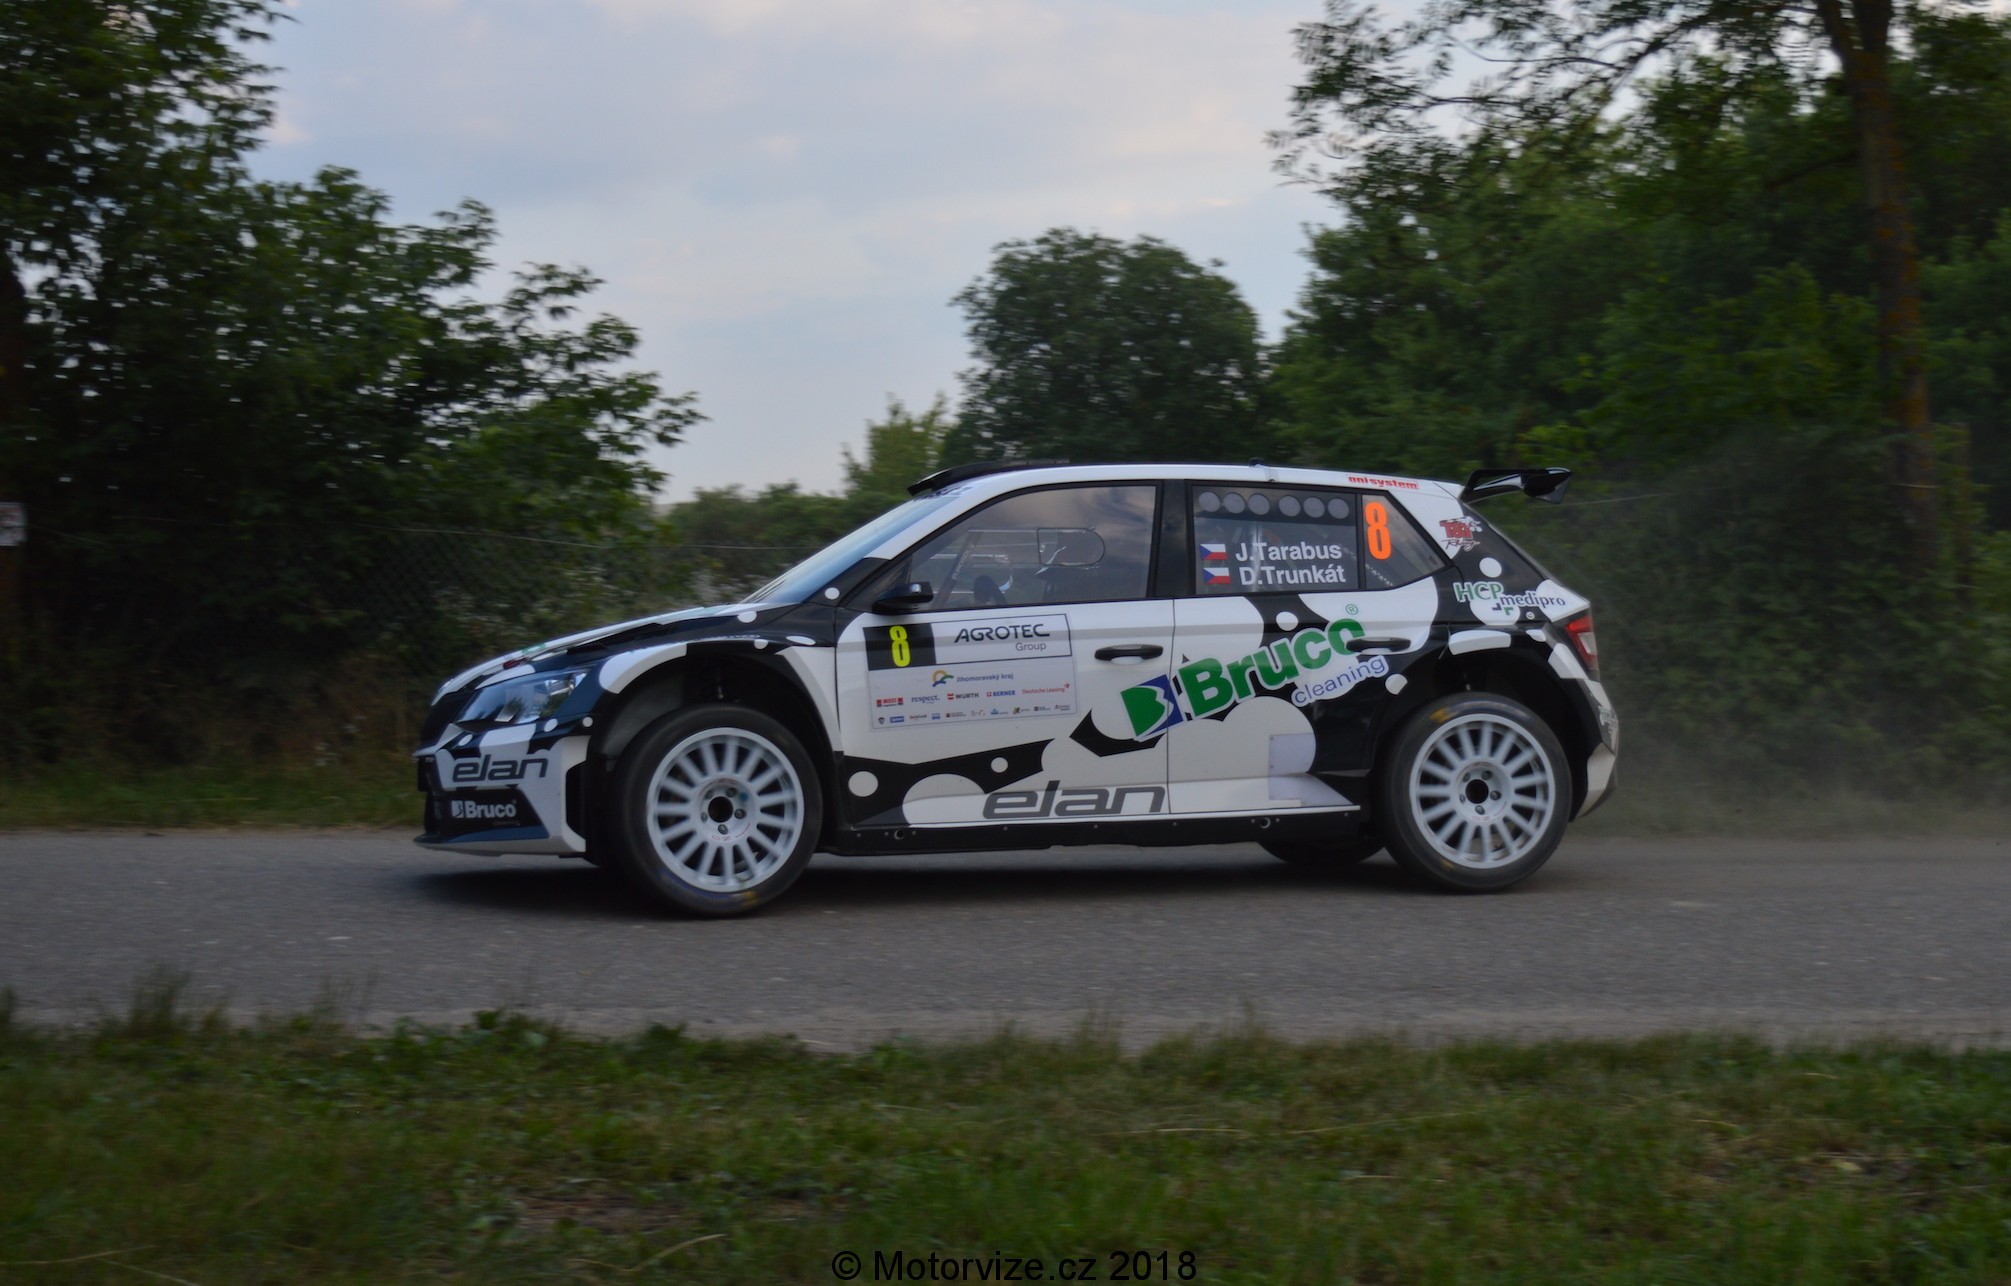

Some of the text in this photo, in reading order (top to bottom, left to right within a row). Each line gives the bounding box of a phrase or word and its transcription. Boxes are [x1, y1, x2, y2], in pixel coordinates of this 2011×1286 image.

[1365, 501, 1392, 560] 8
[1235, 541, 1342, 562] J.Tarabus
[1240, 564, 1346, 586] D.Trunkát
[1454, 582, 1503, 601] HCP
[1500, 591, 1565, 608] medipro
[954, 623, 1050, 643] AGROTEC
[889, 625, 911, 667] 8
[1015, 642, 1047, 652] Group
[1178, 618, 1366, 717] Bruco
[1294, 656, 1386, 705] cleaning
[452, 754, 548, 782] elan
[464, 800, 517, 818] Bruco
[983, 780, 1166, 819] elan
